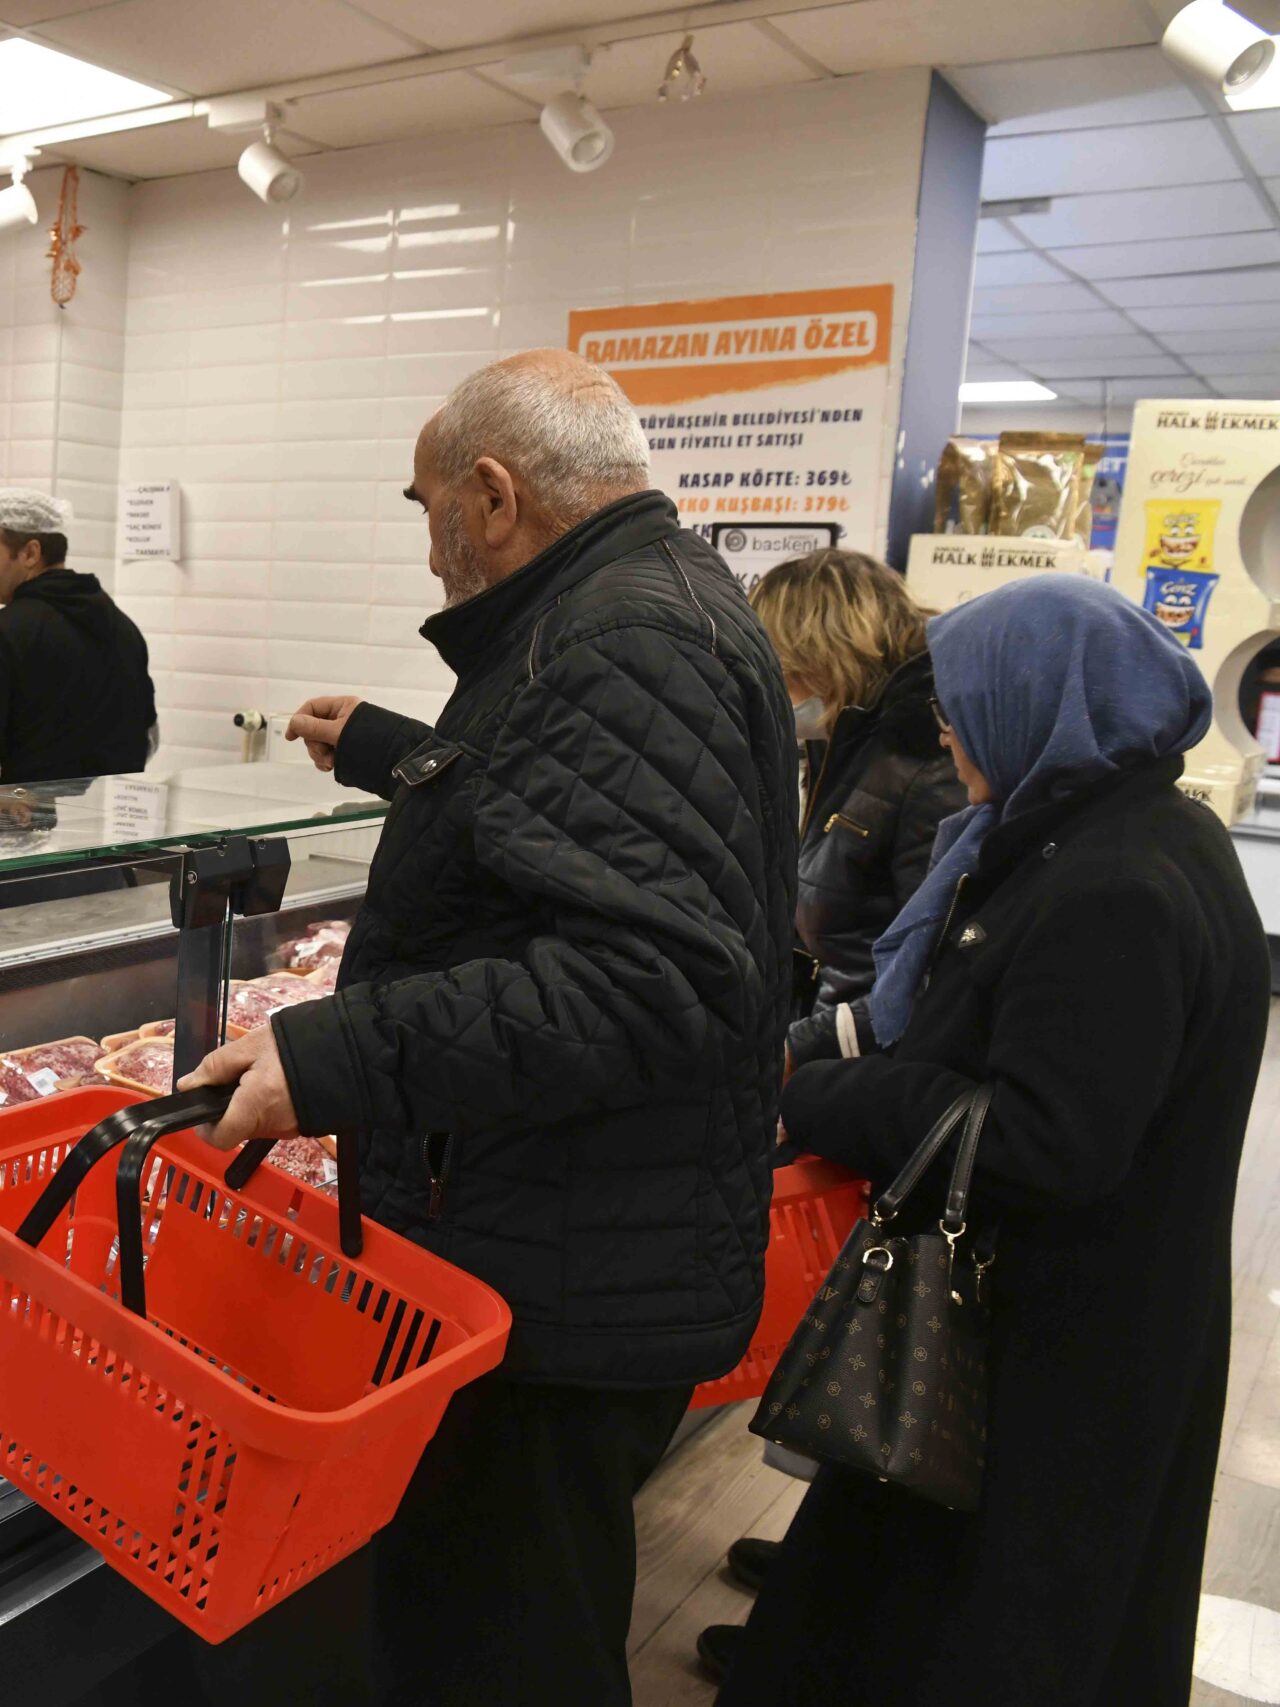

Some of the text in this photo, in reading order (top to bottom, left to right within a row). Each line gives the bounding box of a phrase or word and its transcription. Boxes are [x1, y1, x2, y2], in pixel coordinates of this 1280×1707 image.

[586, 318, 870, 364] RAMAZAN AYINA ÖZEL
[733, 407, 864, 427] BELEDİYESİ'NDEN
[1157, 416, 1278, 430] HALK EKMEK
[649, 432, 804, 451] GUN FİYATLI ET SATIŞI
[679, 472, 734, 489] KASAP
[740, 469, 800, 487] KÖFTE:
[678, 497, 710, 513] EKO
[933, 552, 1056, 568] HALK EKMEK
